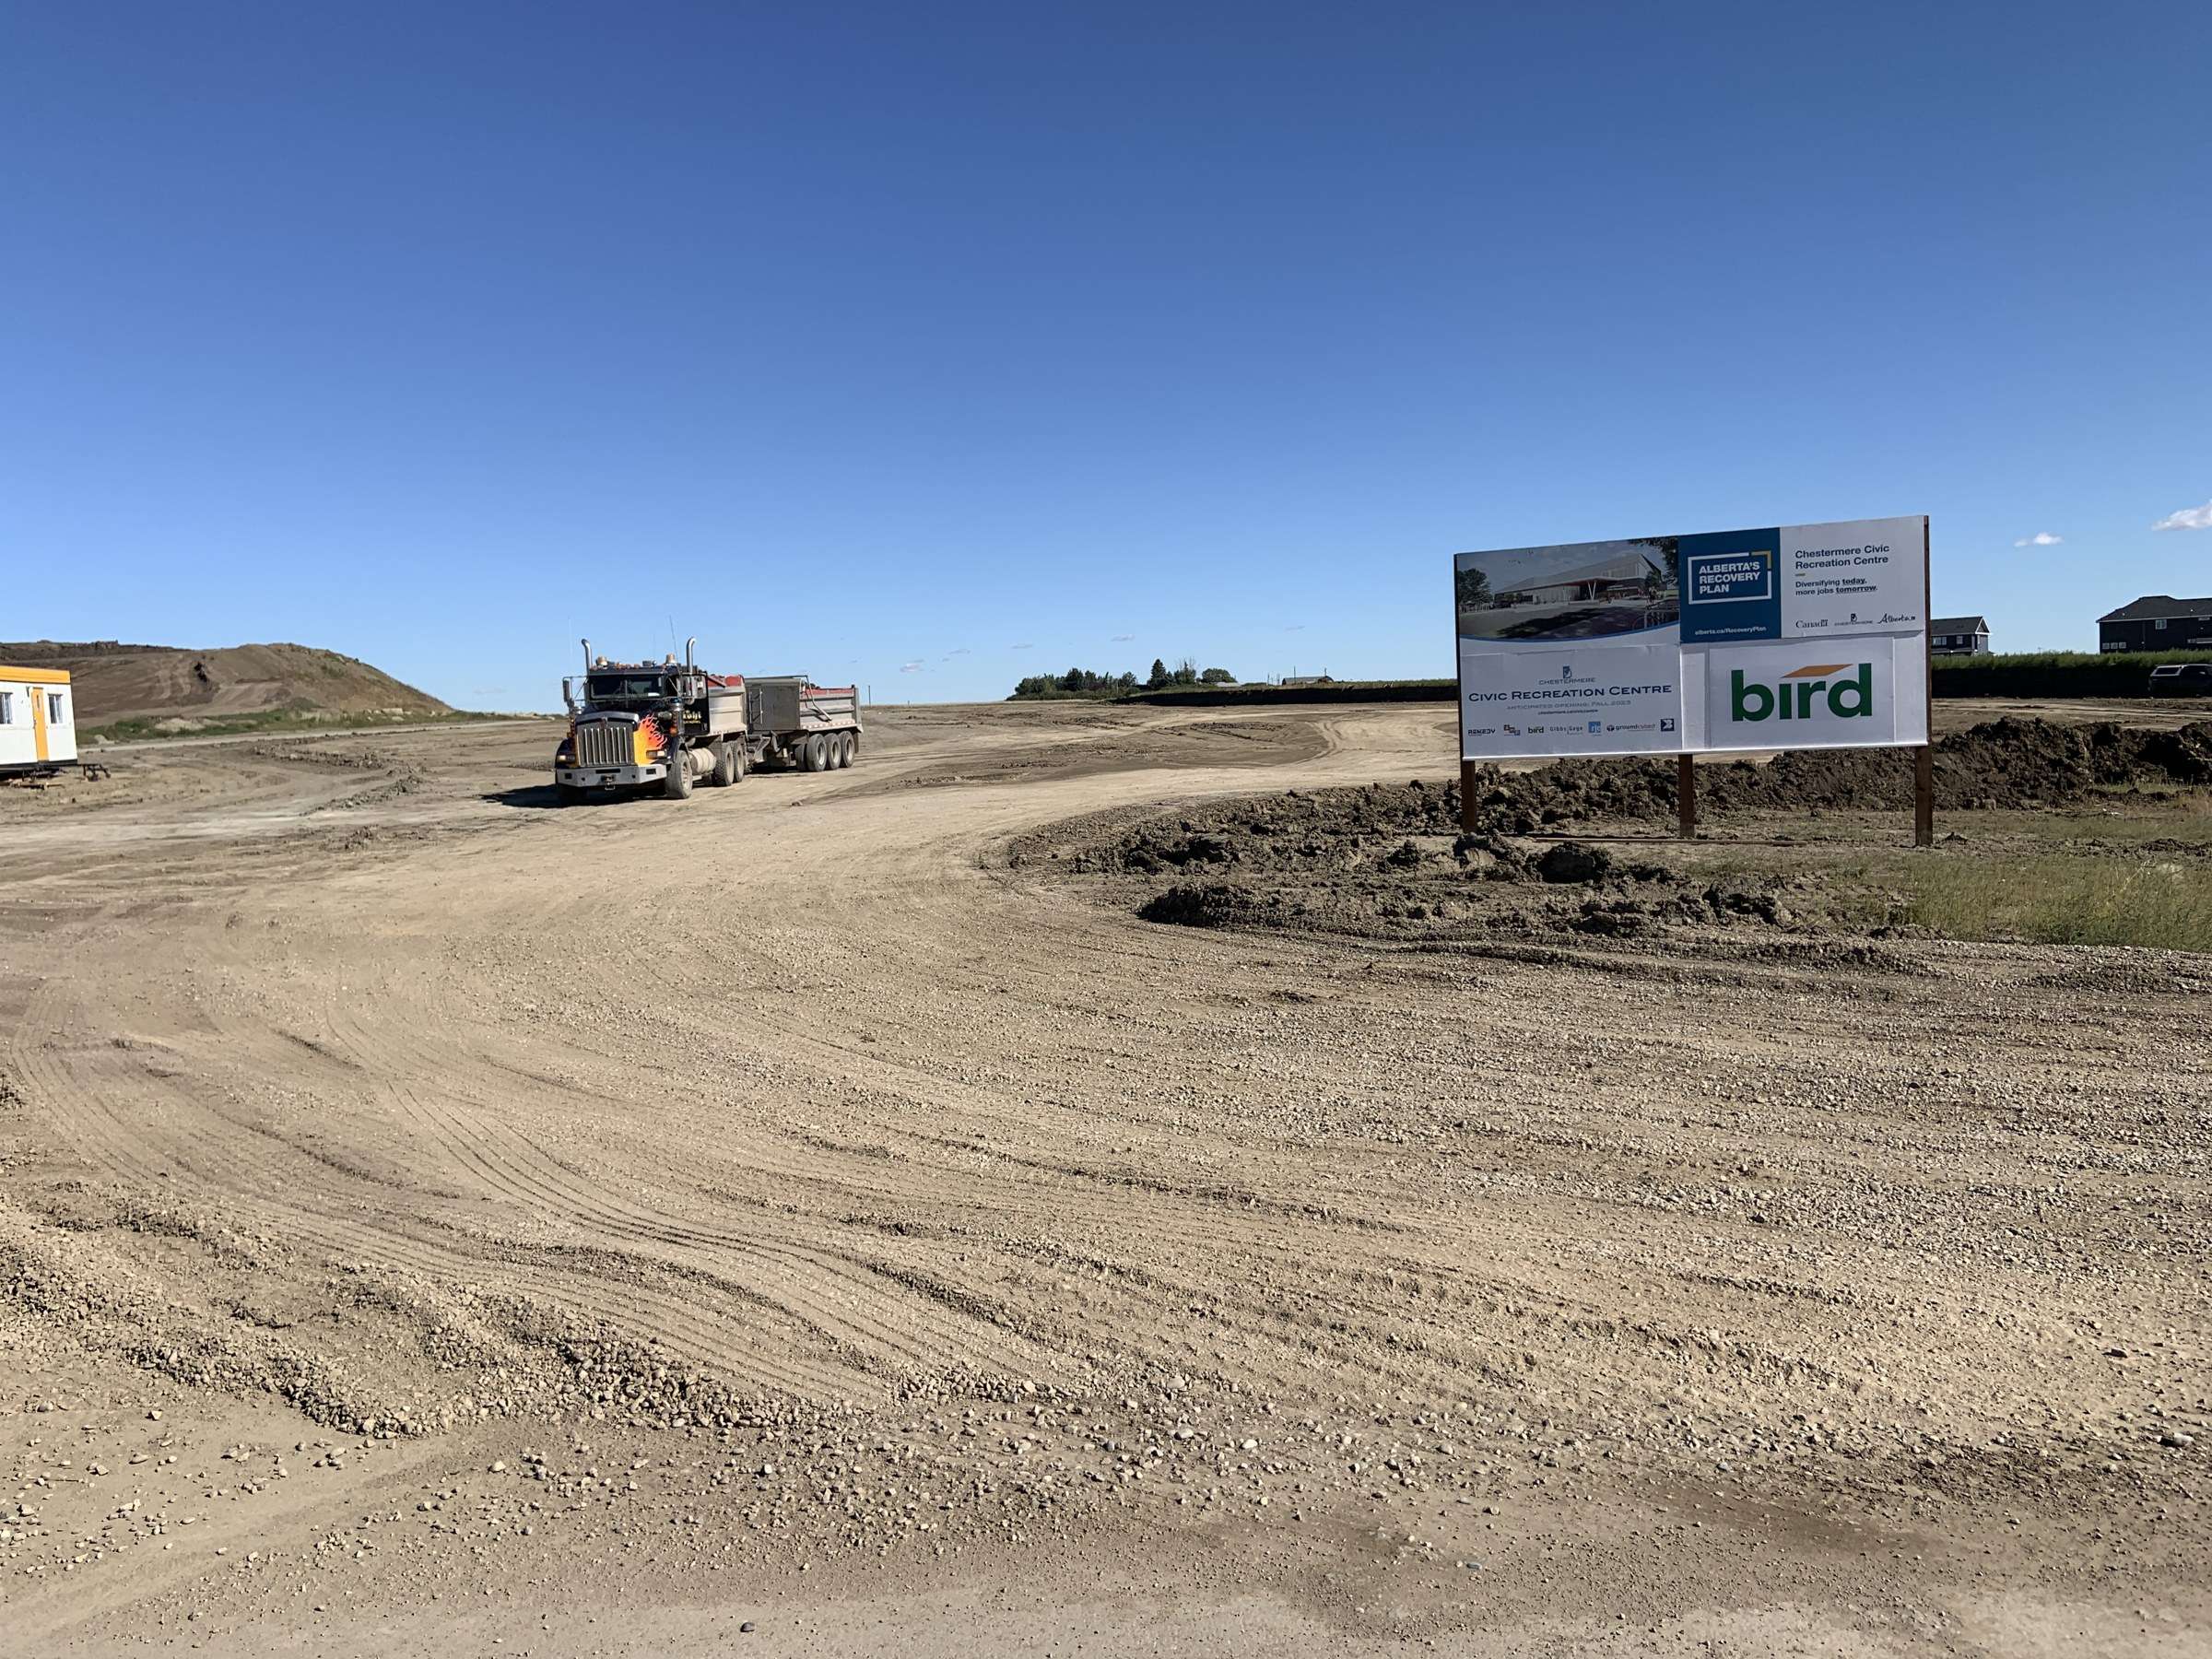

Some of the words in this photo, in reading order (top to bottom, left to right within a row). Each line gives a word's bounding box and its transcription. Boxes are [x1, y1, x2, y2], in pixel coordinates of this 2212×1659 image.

[1795, 548, 1861, 559] Chestermere
[1864, 545, 1889, 554] Civic
[1699, 562, 1760, 574] ALBERTA'S
[1795, 559, 1850, 570] Recreation
[1853, 556, 1888, 565] Centre
[1700, 572, 1760, 584] RECOVERY
[1795, 580, 1840, 588] Diversifying
[1700, 584, 1729, 594] PLAN
[1836, 585, 1878, 594] tomorrow.
[1731, 663, 1872, 722] bird
